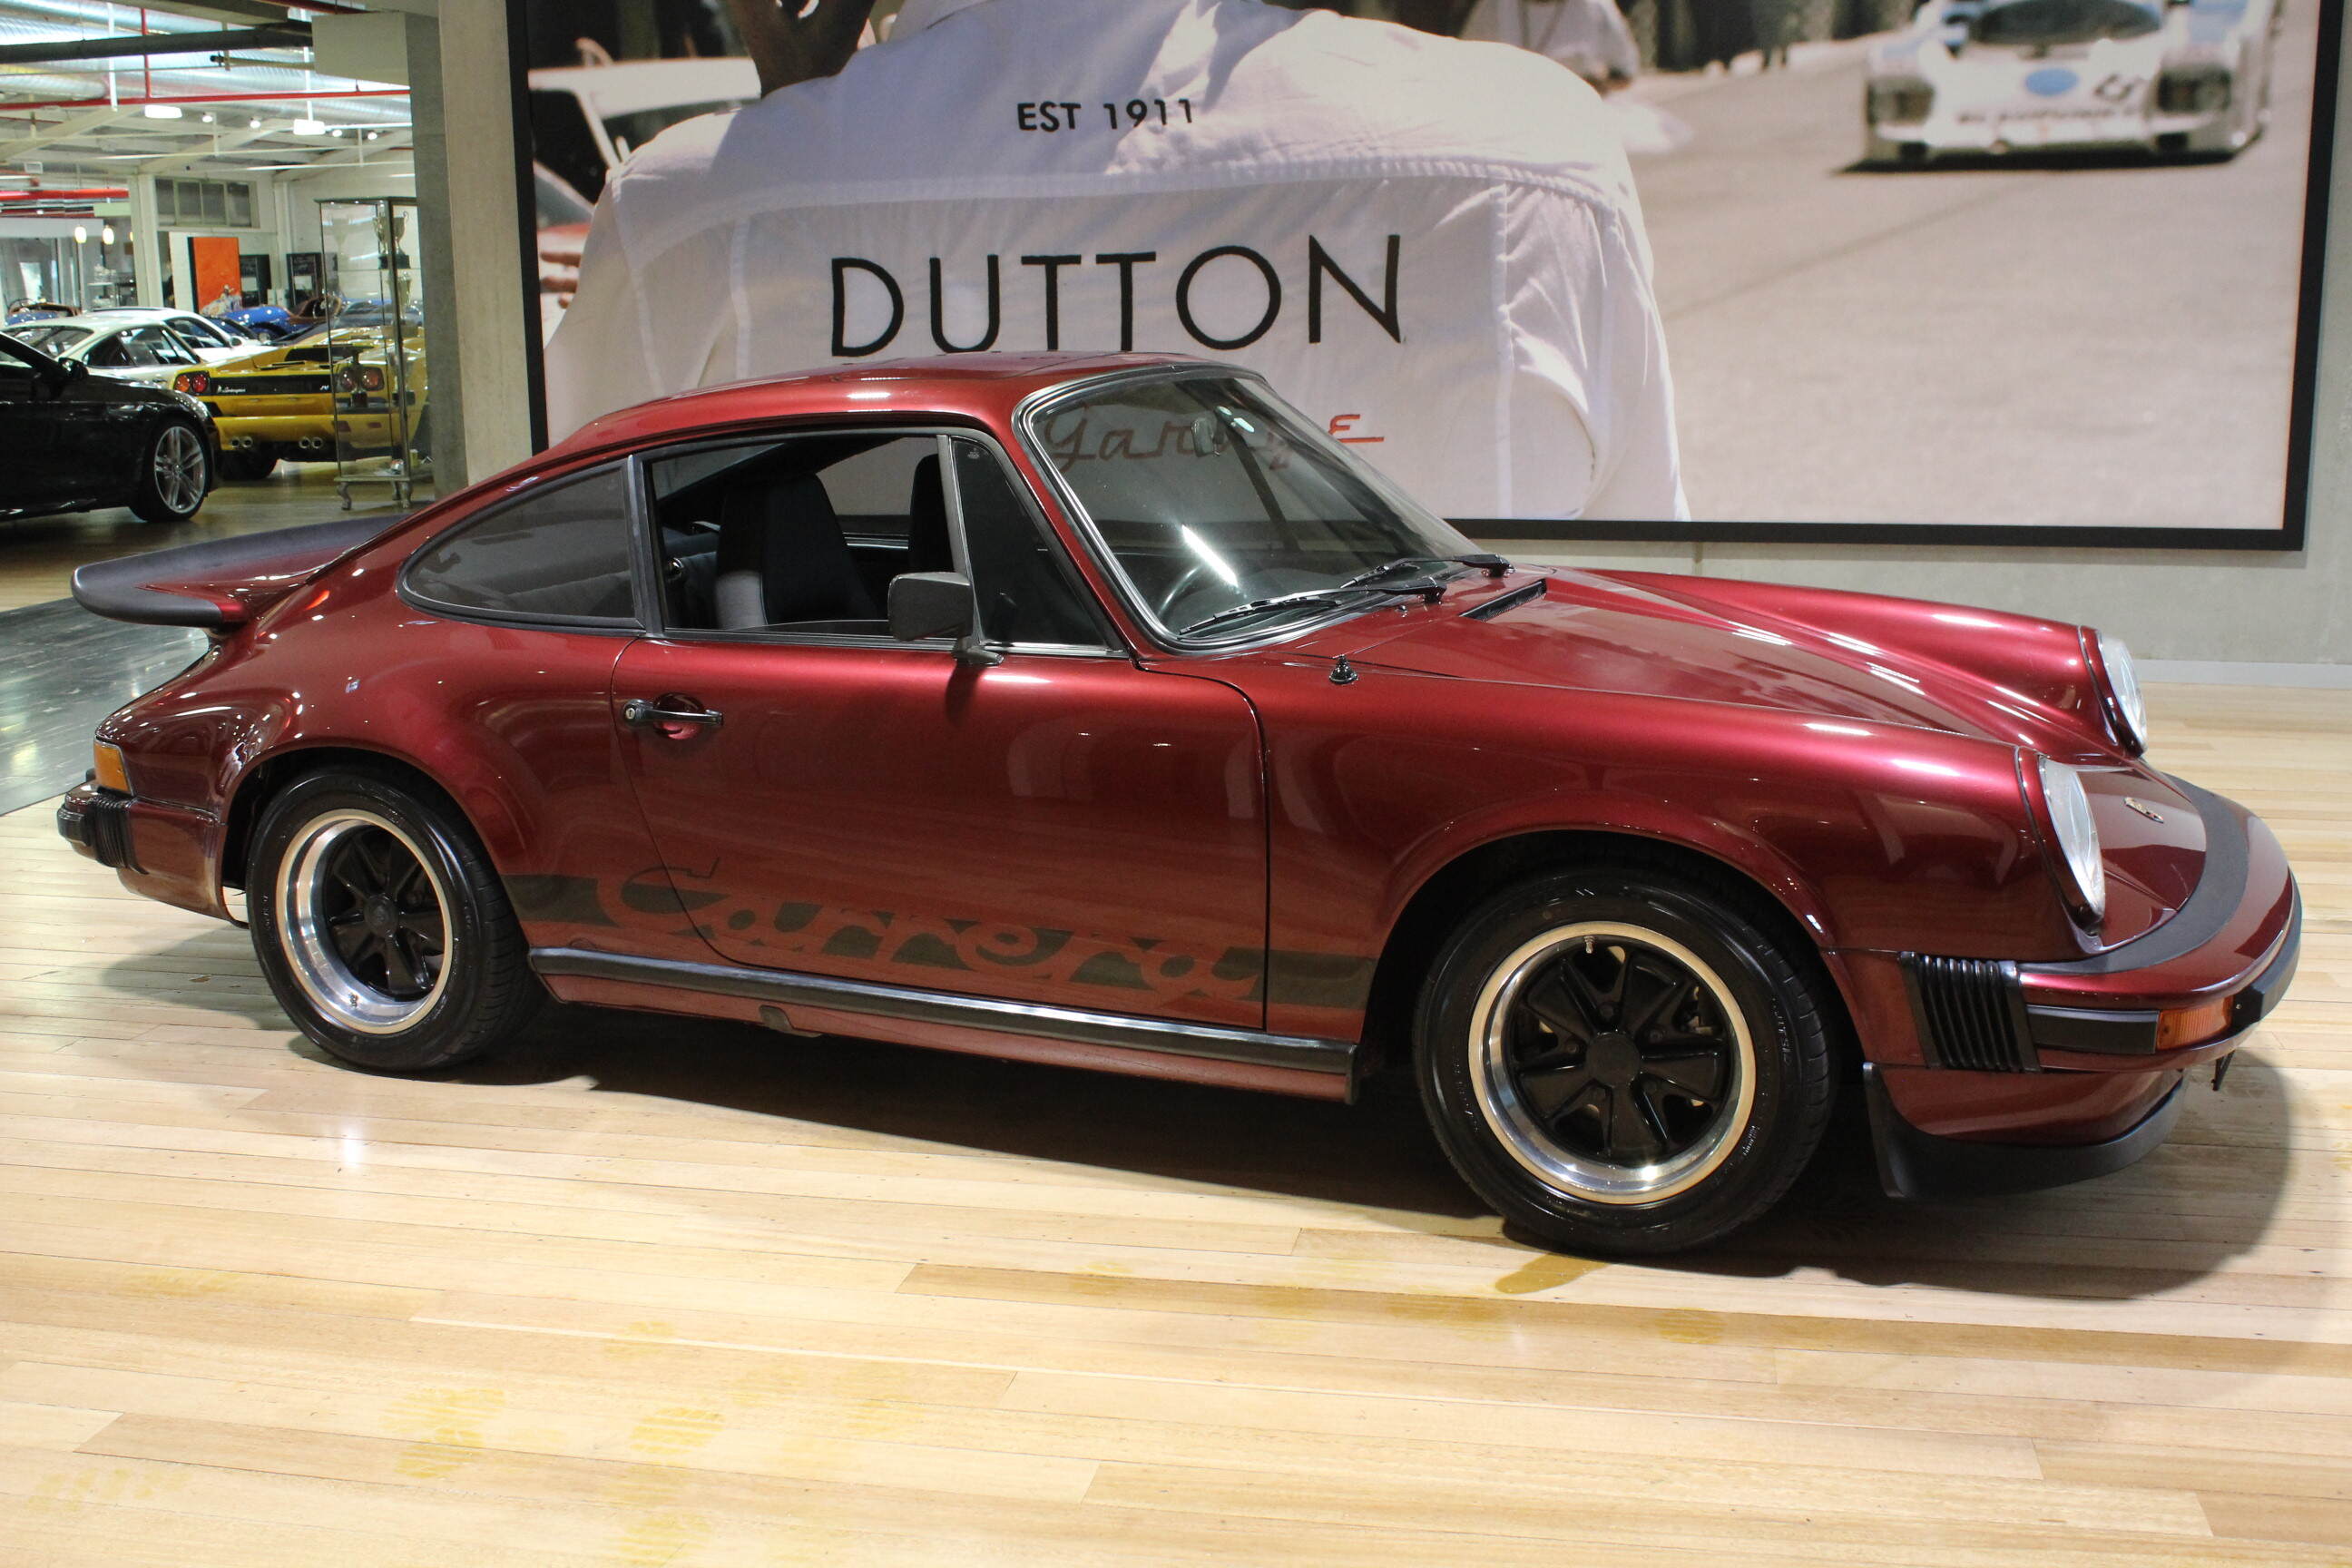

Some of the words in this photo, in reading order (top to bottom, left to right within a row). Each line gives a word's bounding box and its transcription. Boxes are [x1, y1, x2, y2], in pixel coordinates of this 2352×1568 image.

[1017, 102, 1082, 132] EST
[1104, 99, 1195, 130] 1911
[831, 234, 1402, 358] DUTTON
[594, 857, 1262, 1004] Carrera
